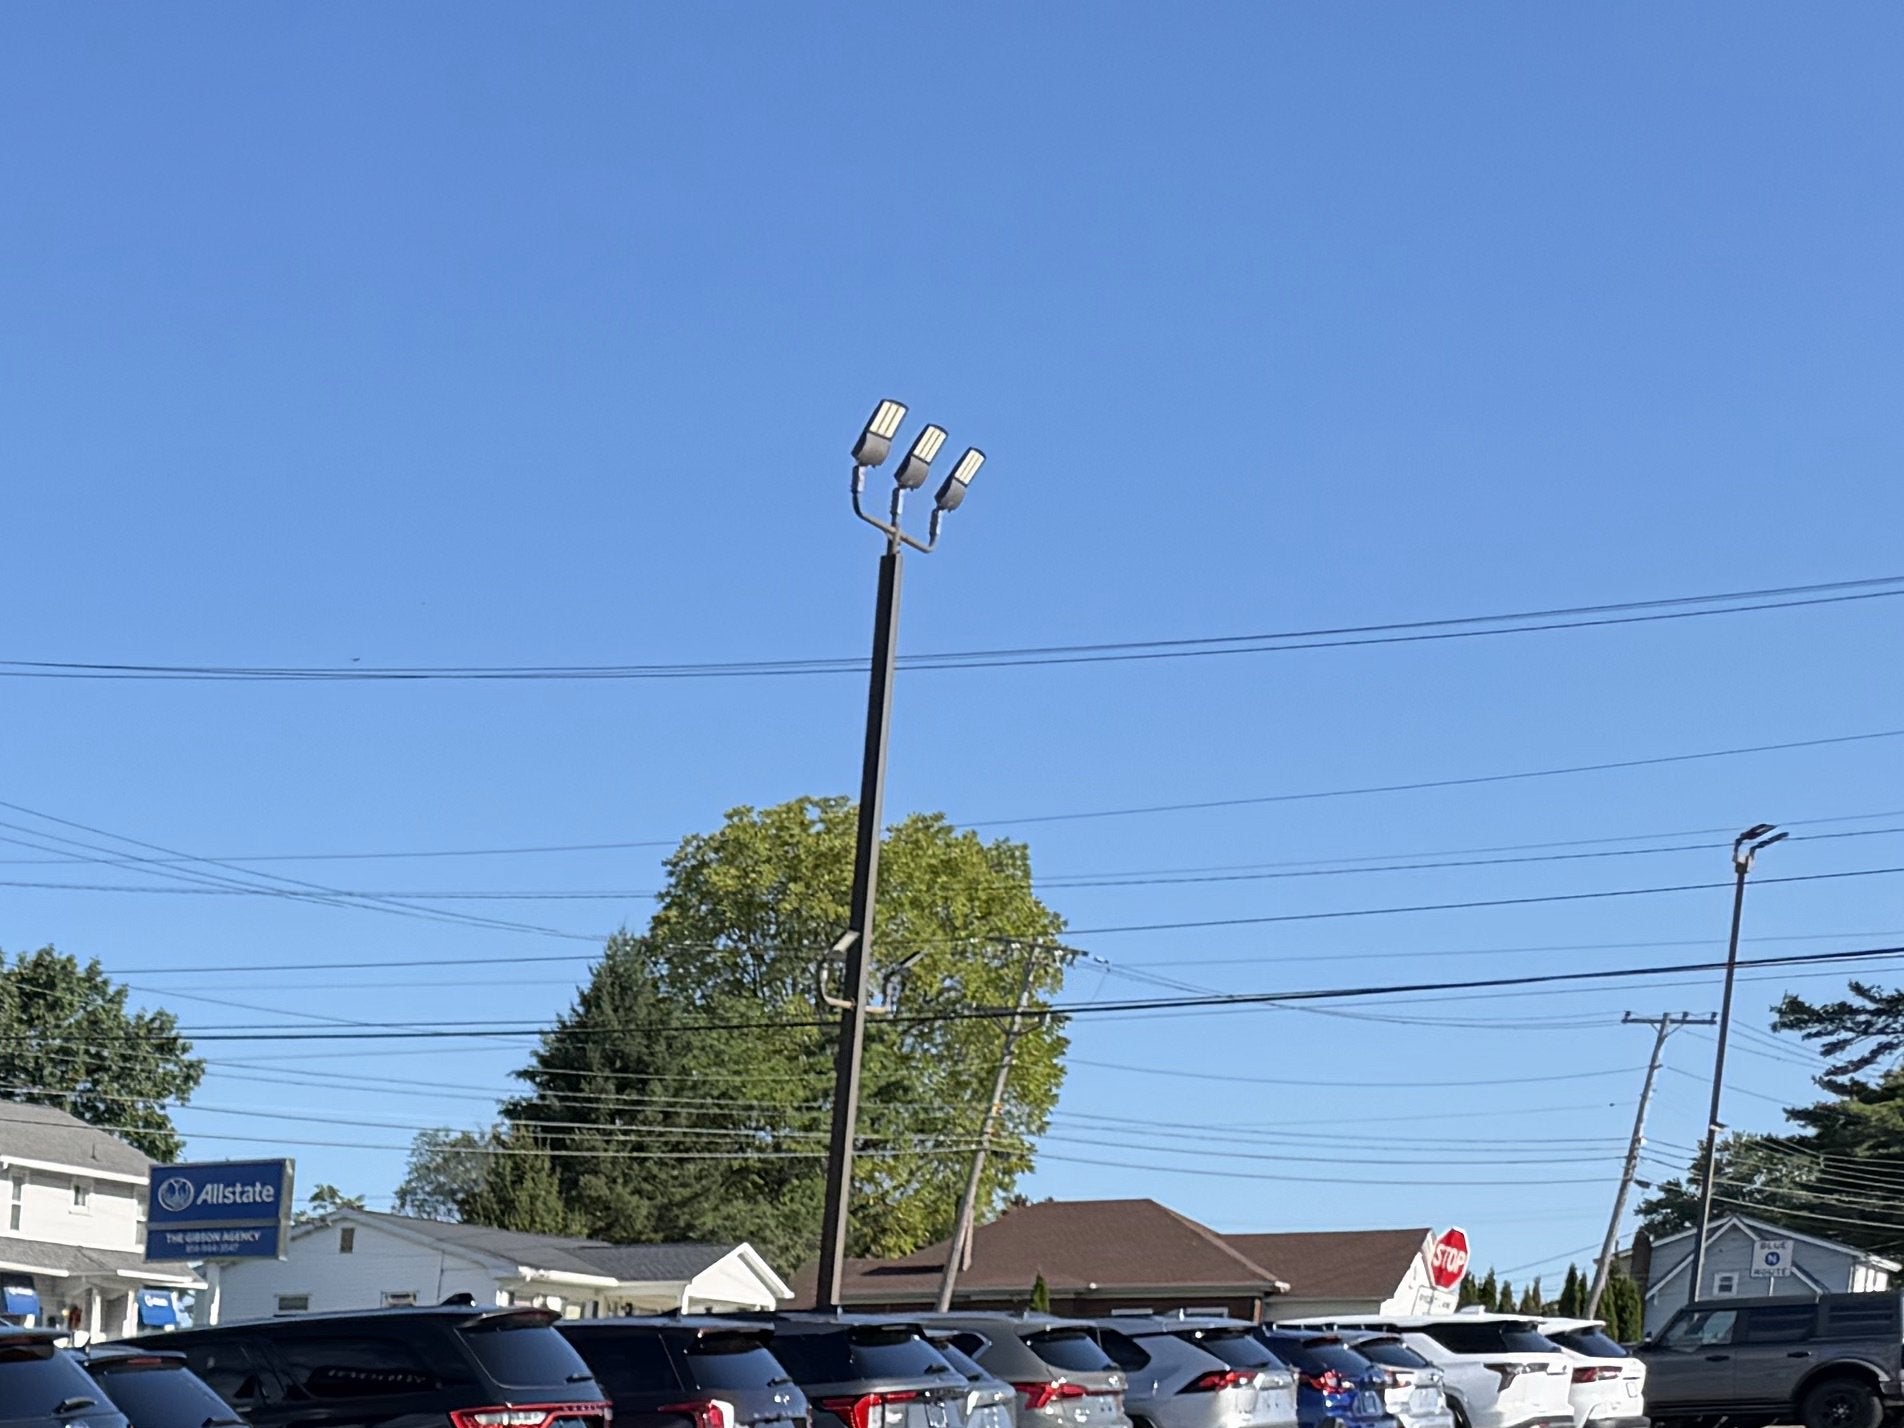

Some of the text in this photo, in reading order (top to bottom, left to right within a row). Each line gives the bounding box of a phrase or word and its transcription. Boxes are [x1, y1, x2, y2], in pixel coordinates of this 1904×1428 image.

[196, 1182, 275, 1205] Allstate
[1760, 1241, 1787, 1250] BLUE
[1433, 1243, 1467, 1273] STOP
